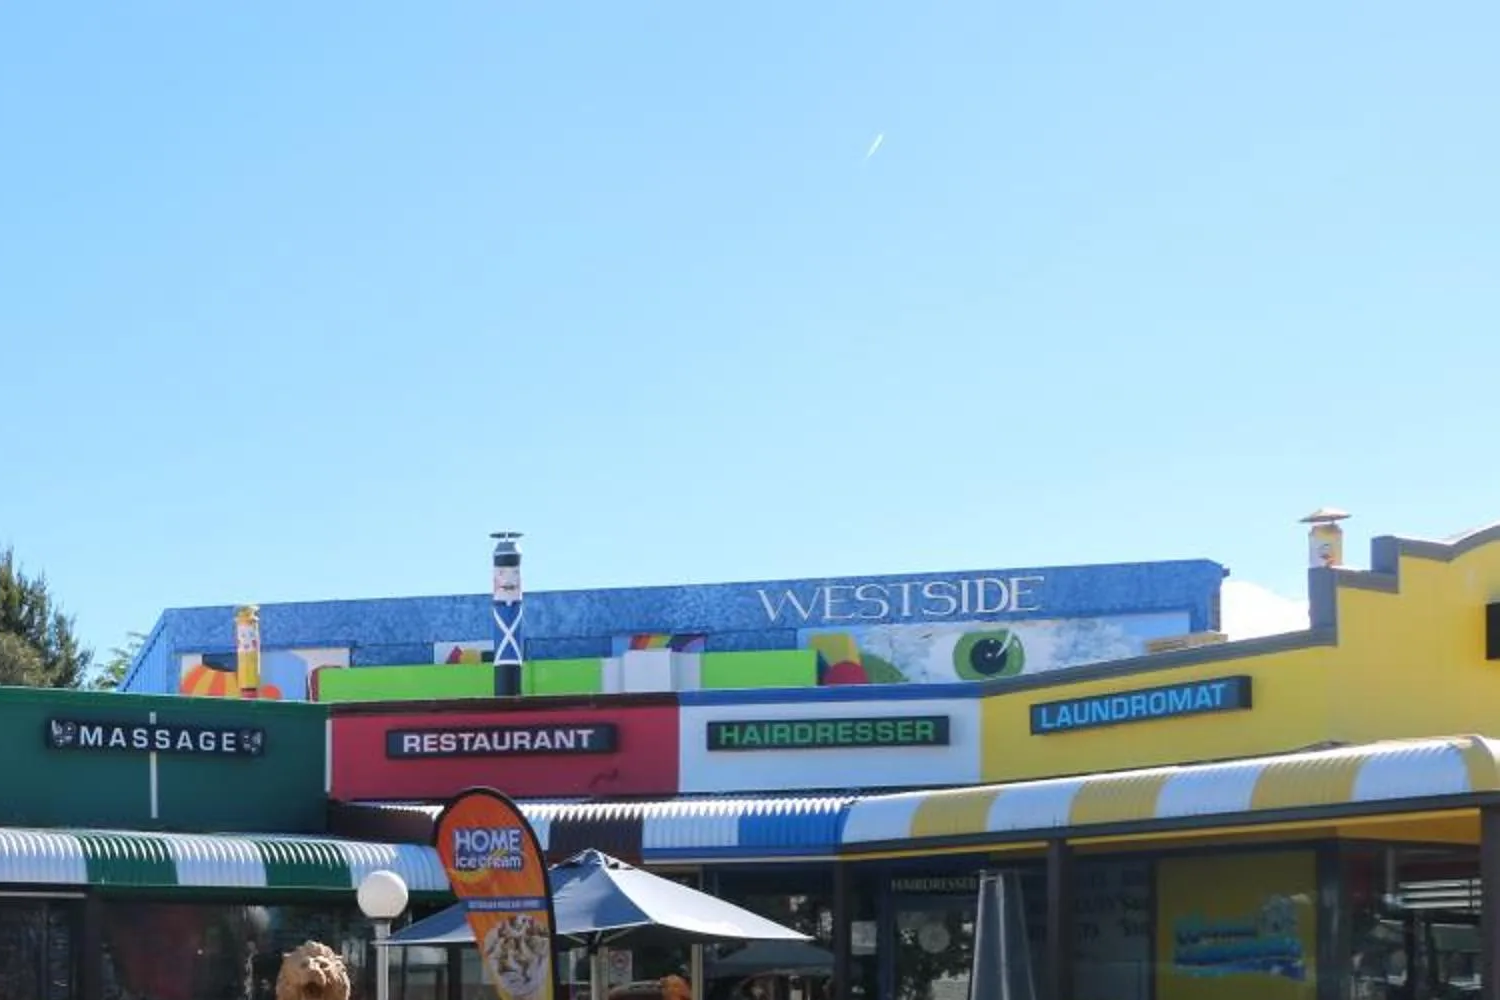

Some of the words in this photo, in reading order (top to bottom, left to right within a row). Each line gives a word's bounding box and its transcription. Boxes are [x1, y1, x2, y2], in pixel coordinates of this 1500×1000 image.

[756, 575, 1044, 621] WESTSIDE
[1041, 683, 1225, 729] LAUNDROMAT
[79, 726, 236, 751] MASSAGE
[403, 729, 594, 753] RESTAURANT
[720, 720, 935, 746] HAIRDRESSER
[454, 828, 521, 853] HOME
